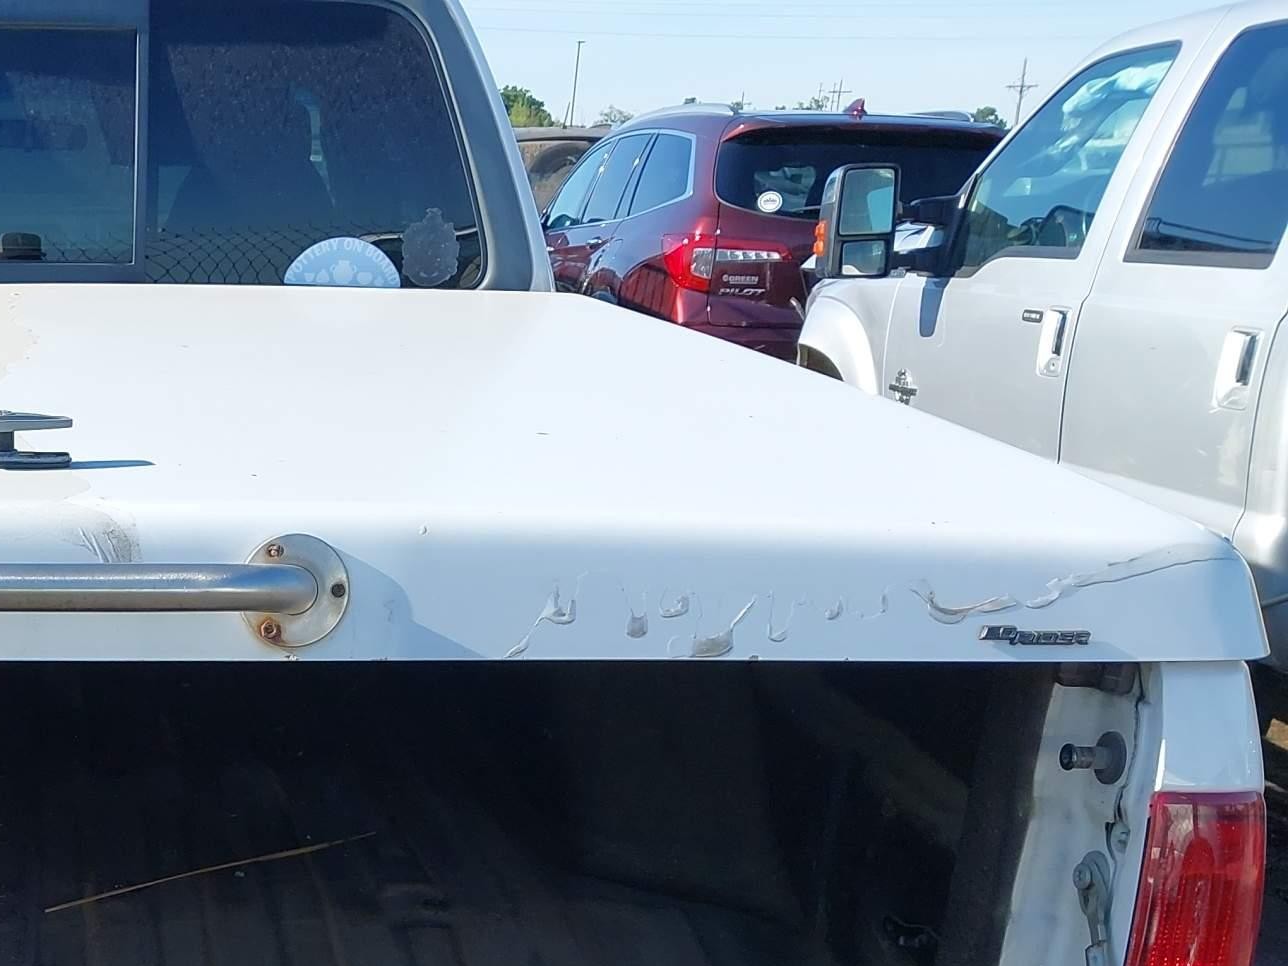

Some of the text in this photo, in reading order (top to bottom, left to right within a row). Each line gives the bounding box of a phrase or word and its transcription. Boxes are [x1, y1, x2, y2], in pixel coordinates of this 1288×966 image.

[285, 238, 339, 283] POTTERY
[343, 239, 365, 253] ON
[718, 288, 766, 296] PILOT
